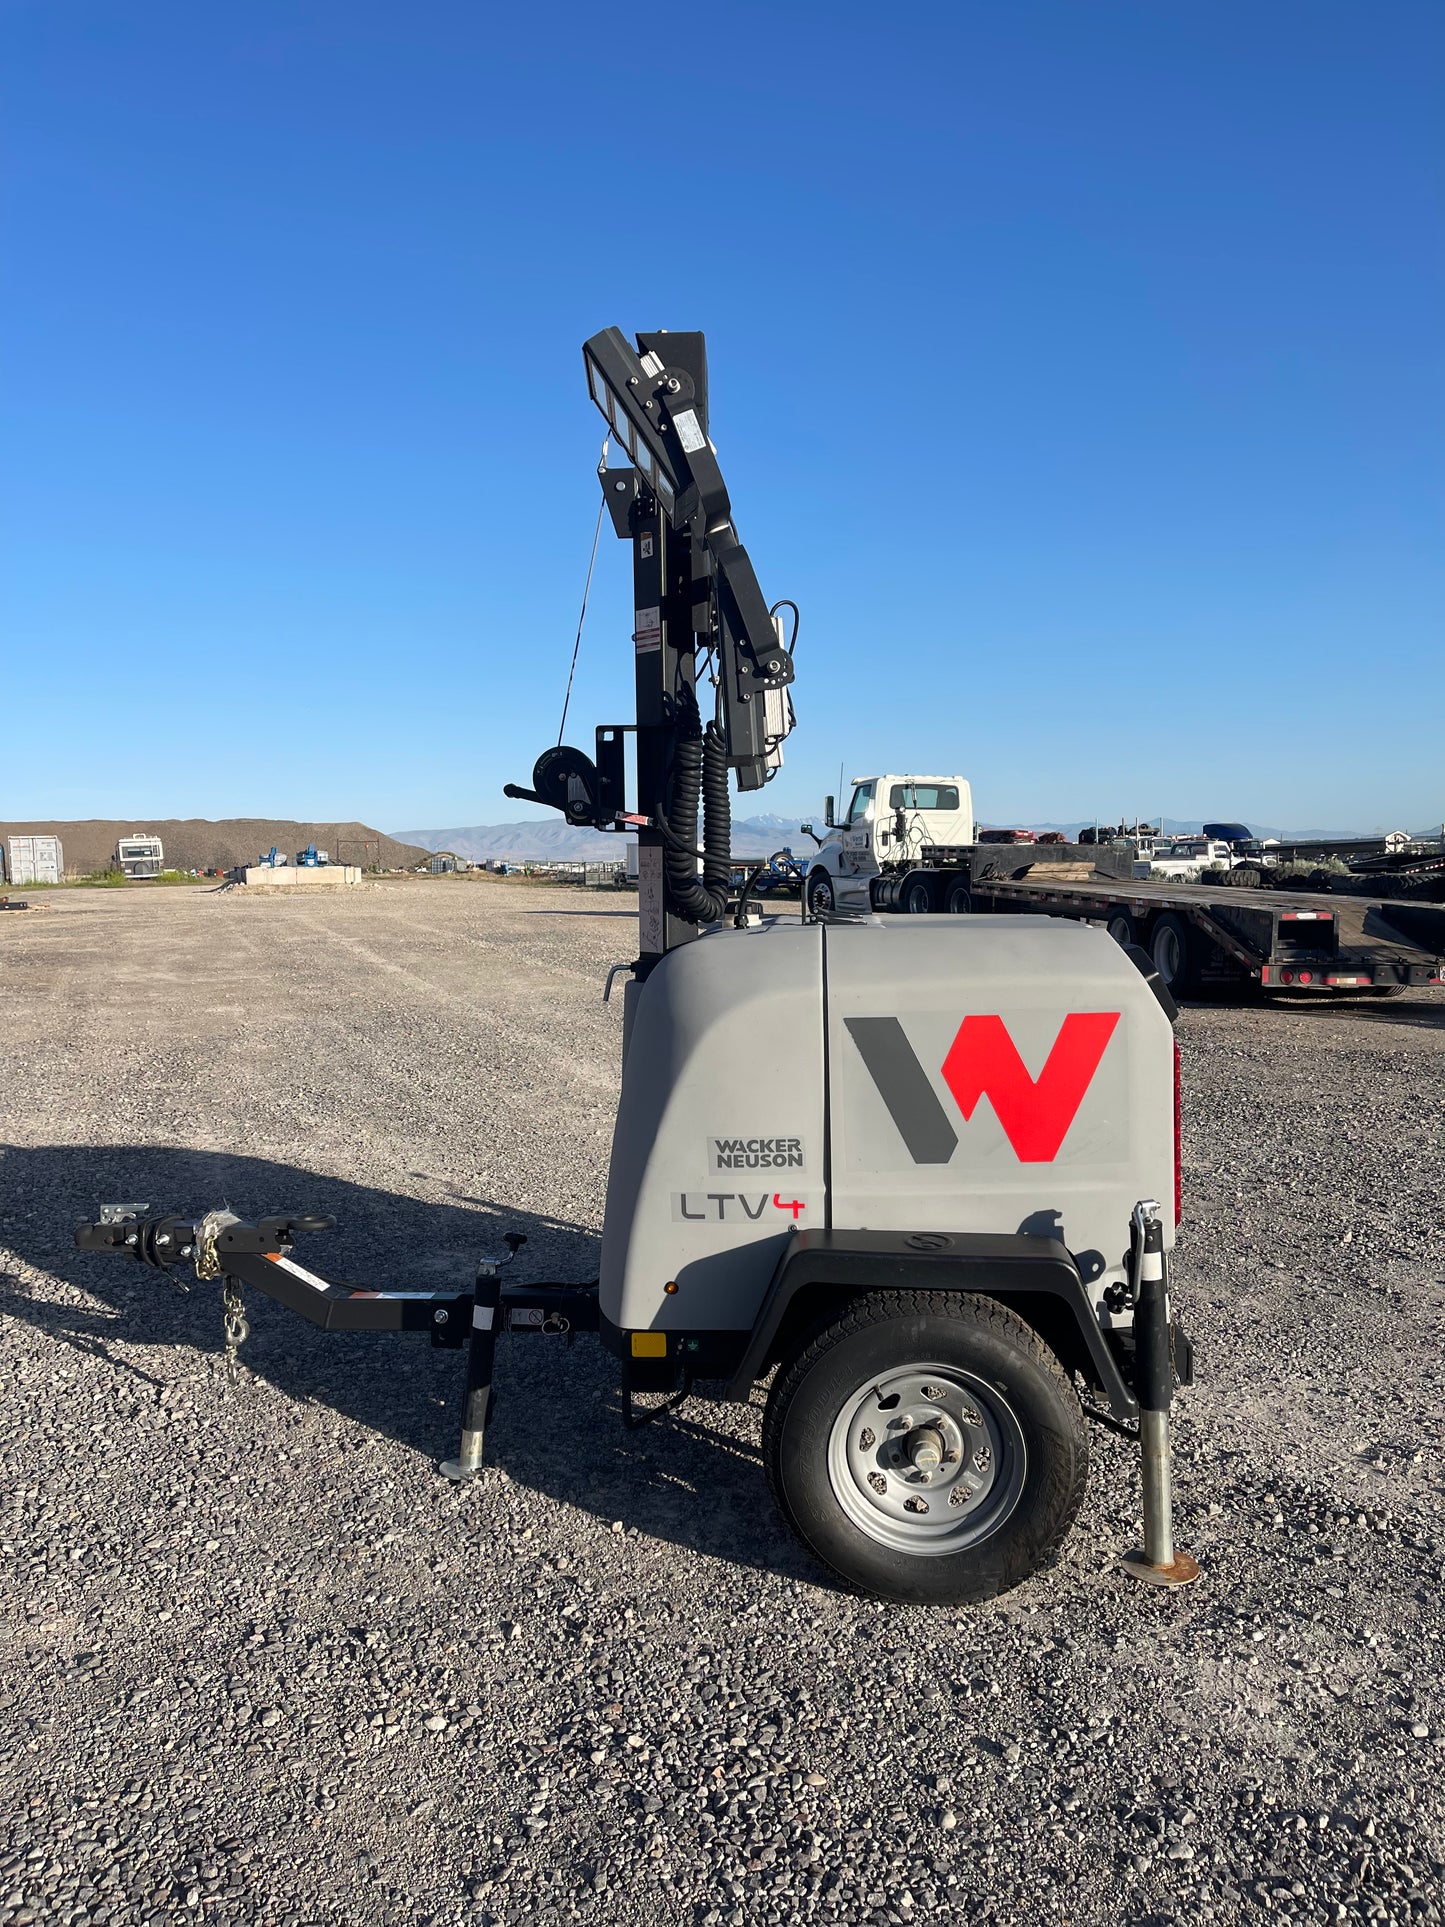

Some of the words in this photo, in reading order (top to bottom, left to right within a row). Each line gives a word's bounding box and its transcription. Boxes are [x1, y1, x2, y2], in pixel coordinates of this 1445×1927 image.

[715, 1139, 802, 1154] WACKER
[717, 1153, 804, 1168] NEUSON
[681, 1193, 806, 1220] LTV4
